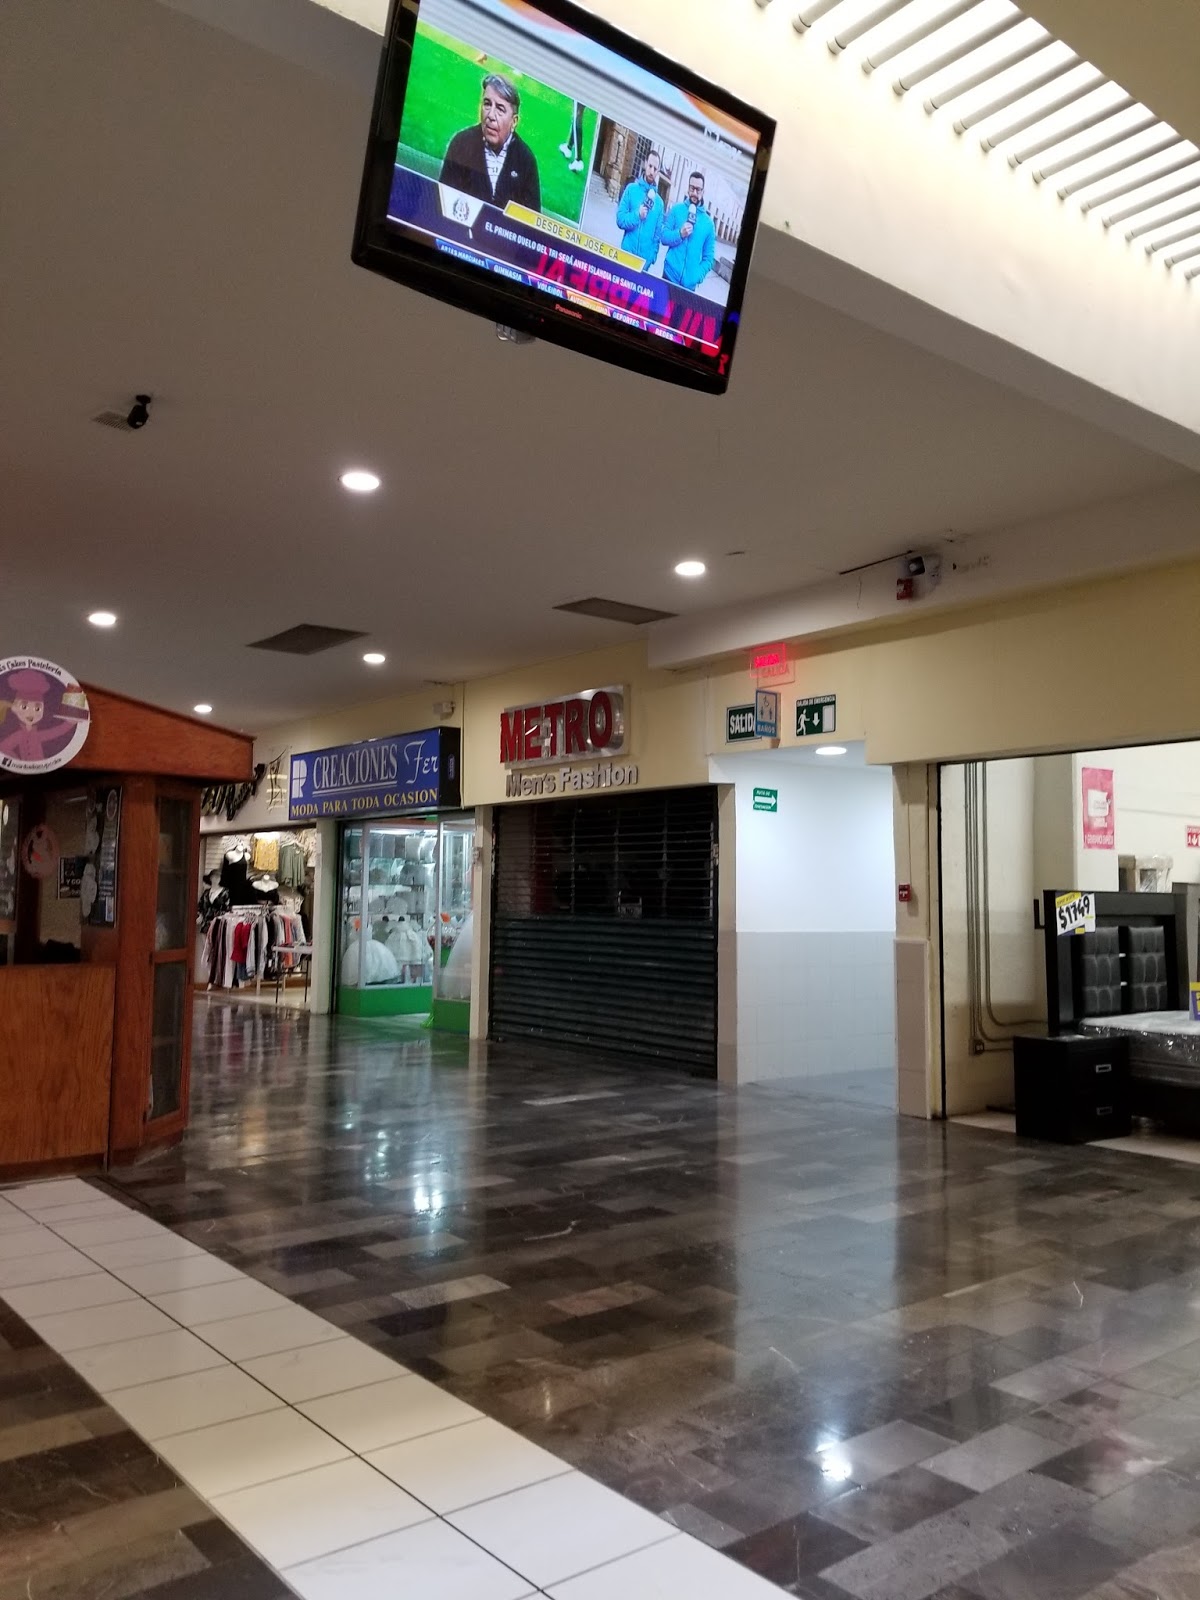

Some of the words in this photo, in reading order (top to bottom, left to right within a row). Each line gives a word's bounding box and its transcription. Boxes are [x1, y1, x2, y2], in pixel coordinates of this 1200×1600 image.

[536, 217, 564, 237] DESDE
[565, 228, 581, 244] SAN
[608, 248, 619, 260] CA
[485, 221, 494, 233] EL
[494, 225, 518, 242] PRIMER
[517, 234, 537, 250] DUELO
[536, 243, 548, 256] DEL
[548, 247, 558, 259] TRI
[558, 252, 574, 266] SERÁ
[572, 259, 588, 273] ANTE
[588, 264, 612, 283] ISLANDIA
[612, 274, 621, 284] EN
[620, 278, 637, 292] SANTA
[636, 285, 655, 299] CLARA
[554, 303, 583, 320] Panasonic
[654, 327, 675, 341] REDES
[499, 691, 613, 764] METRO
[729, 712, 755, 735] SALID
[312, 743, 398, 790] CREACIONES
[505, 771, 557, 798] Men's
[559, 762, 639, 793] Fashion
[291, 804, 319, 817] MODA
[322, 800, 348, 814] PARA
[351, 795, 380, 811] TODA
[383, 788, 438, 807] OCASION
